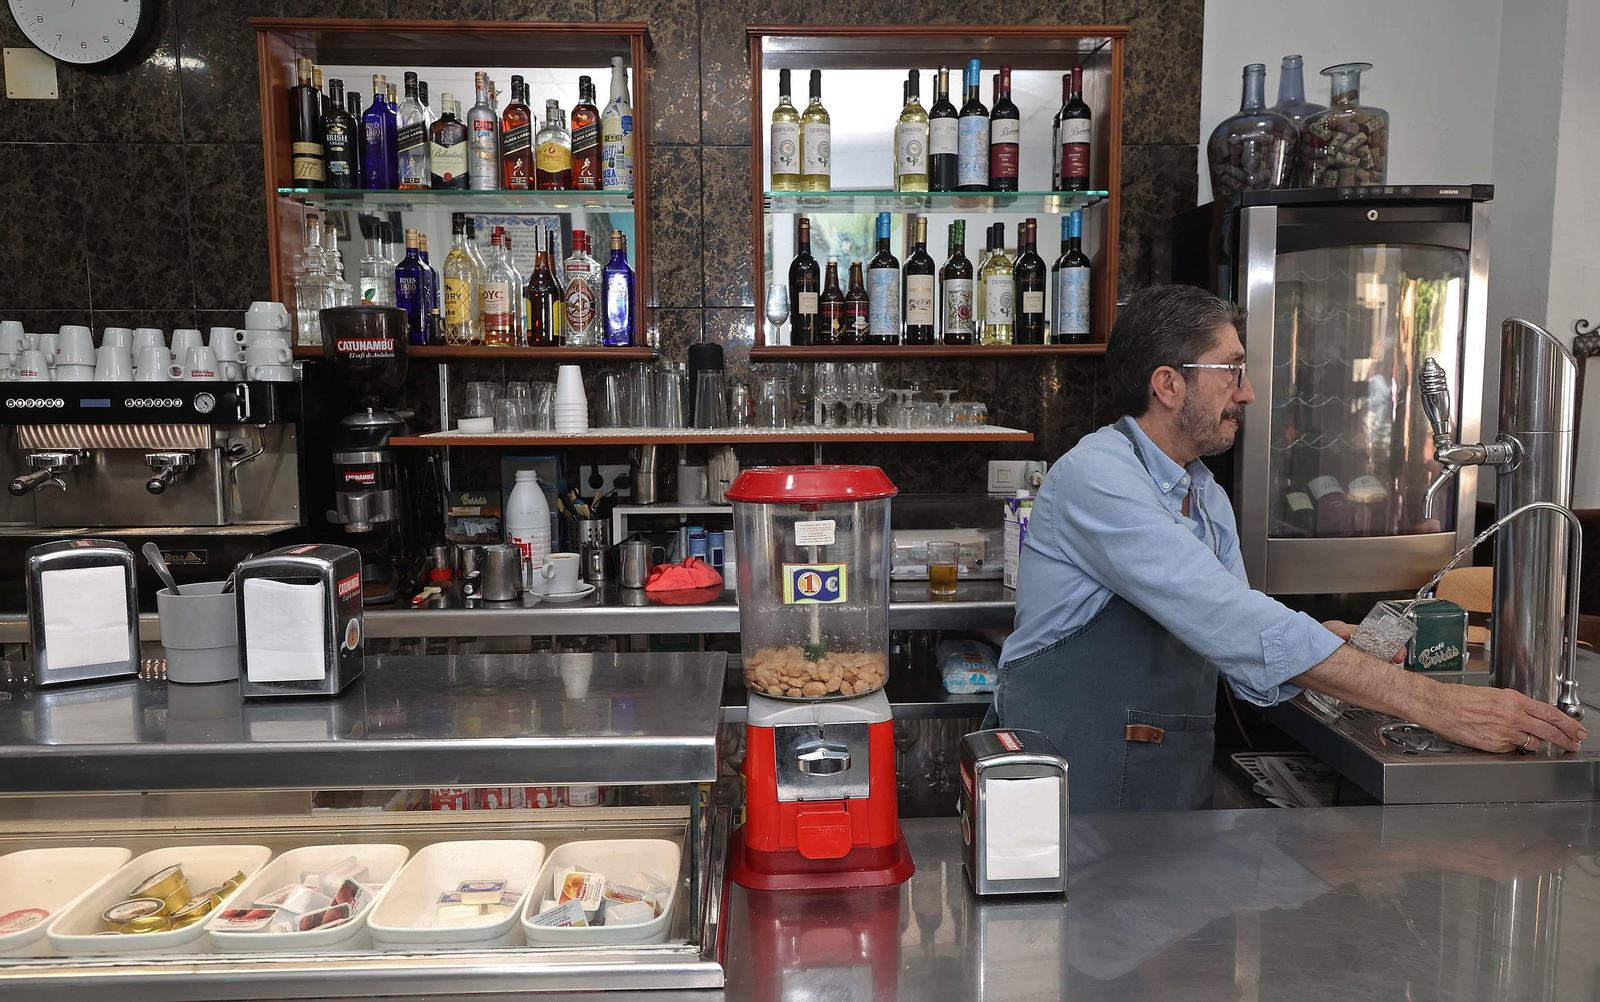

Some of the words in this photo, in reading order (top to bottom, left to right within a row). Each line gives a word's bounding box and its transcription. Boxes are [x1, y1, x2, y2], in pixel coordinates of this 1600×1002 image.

[37, 15, 44, 24] 8
[118, 18, 125, 26] 4
[56, 34, 63, 42] 7
[102, 35, 110, 44] 5
[80, 41, 87, 49] 6
[326, 134, 348, 143] IRISH
[337, 339, 394, 351] CATUNAMBÚ
[804, 574, 815, 593] 1
[1430, 641, 1446, 653] Café
